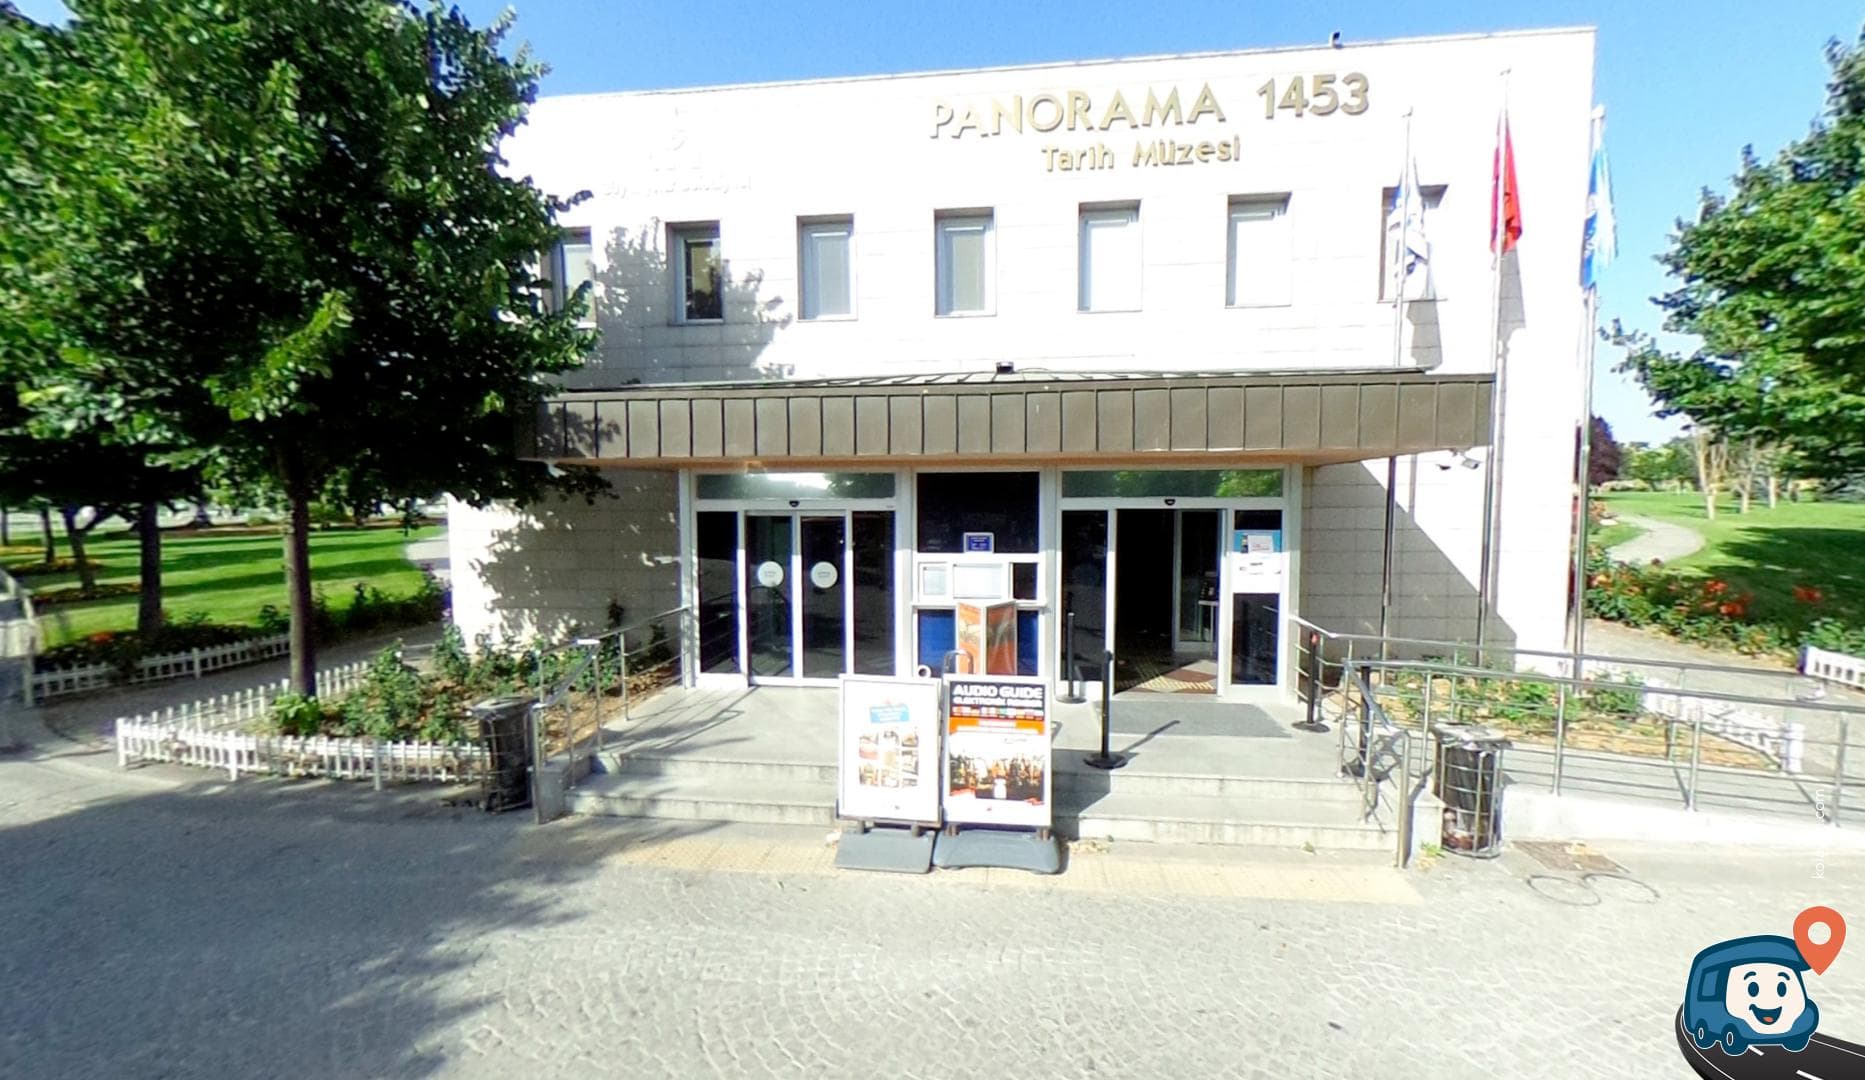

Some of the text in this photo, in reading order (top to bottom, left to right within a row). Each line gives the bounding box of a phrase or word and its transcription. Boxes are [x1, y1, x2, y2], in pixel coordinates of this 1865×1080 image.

[930, 72, 1370, 138] PANORAMA 1453
[1041, 135, 1241, 172] Tarih Müzesi
[952, 684, 1043, 699] AUDIO GUIDE
